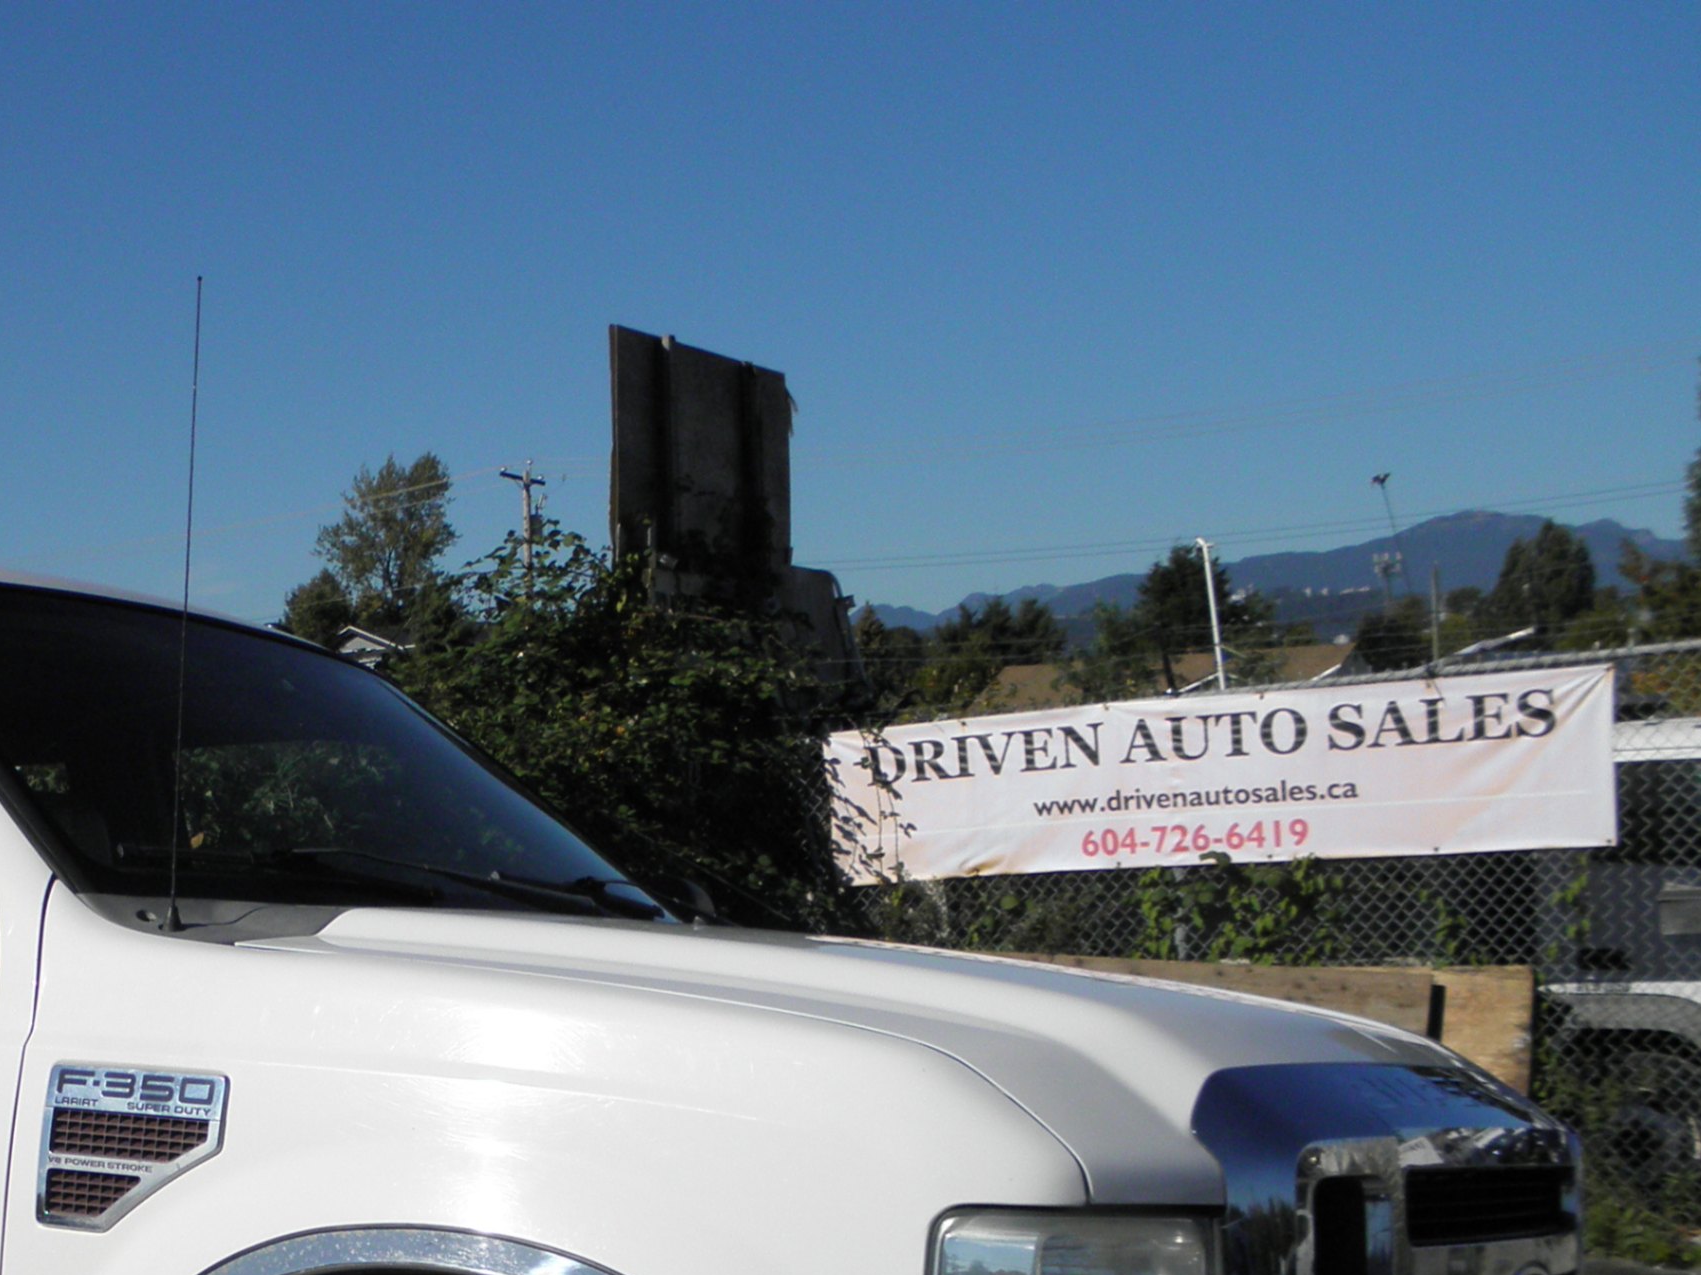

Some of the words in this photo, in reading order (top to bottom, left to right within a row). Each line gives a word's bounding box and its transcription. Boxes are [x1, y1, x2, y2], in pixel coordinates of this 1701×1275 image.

[865, 723, 1104, 787] DRIVEN
[1119, 706, 1309, 764] AUTO
[1328, 688, 1558, 750] SALES
[1033, 778, 1358, 818] www.drivenautosales.ca
[1080, 818, 1310, 857] 604-726-6419
[54, 1096, 99, 1107] LARIAT
[56, 1068, 215, 1106] F-350
[126, 1101, 171, 1114] SUPER
[173, 1106, 211, 1117] DUTY
[64, 1157, 106, 1169] POWER
[107, 1162, 153, 1173] STROKE
